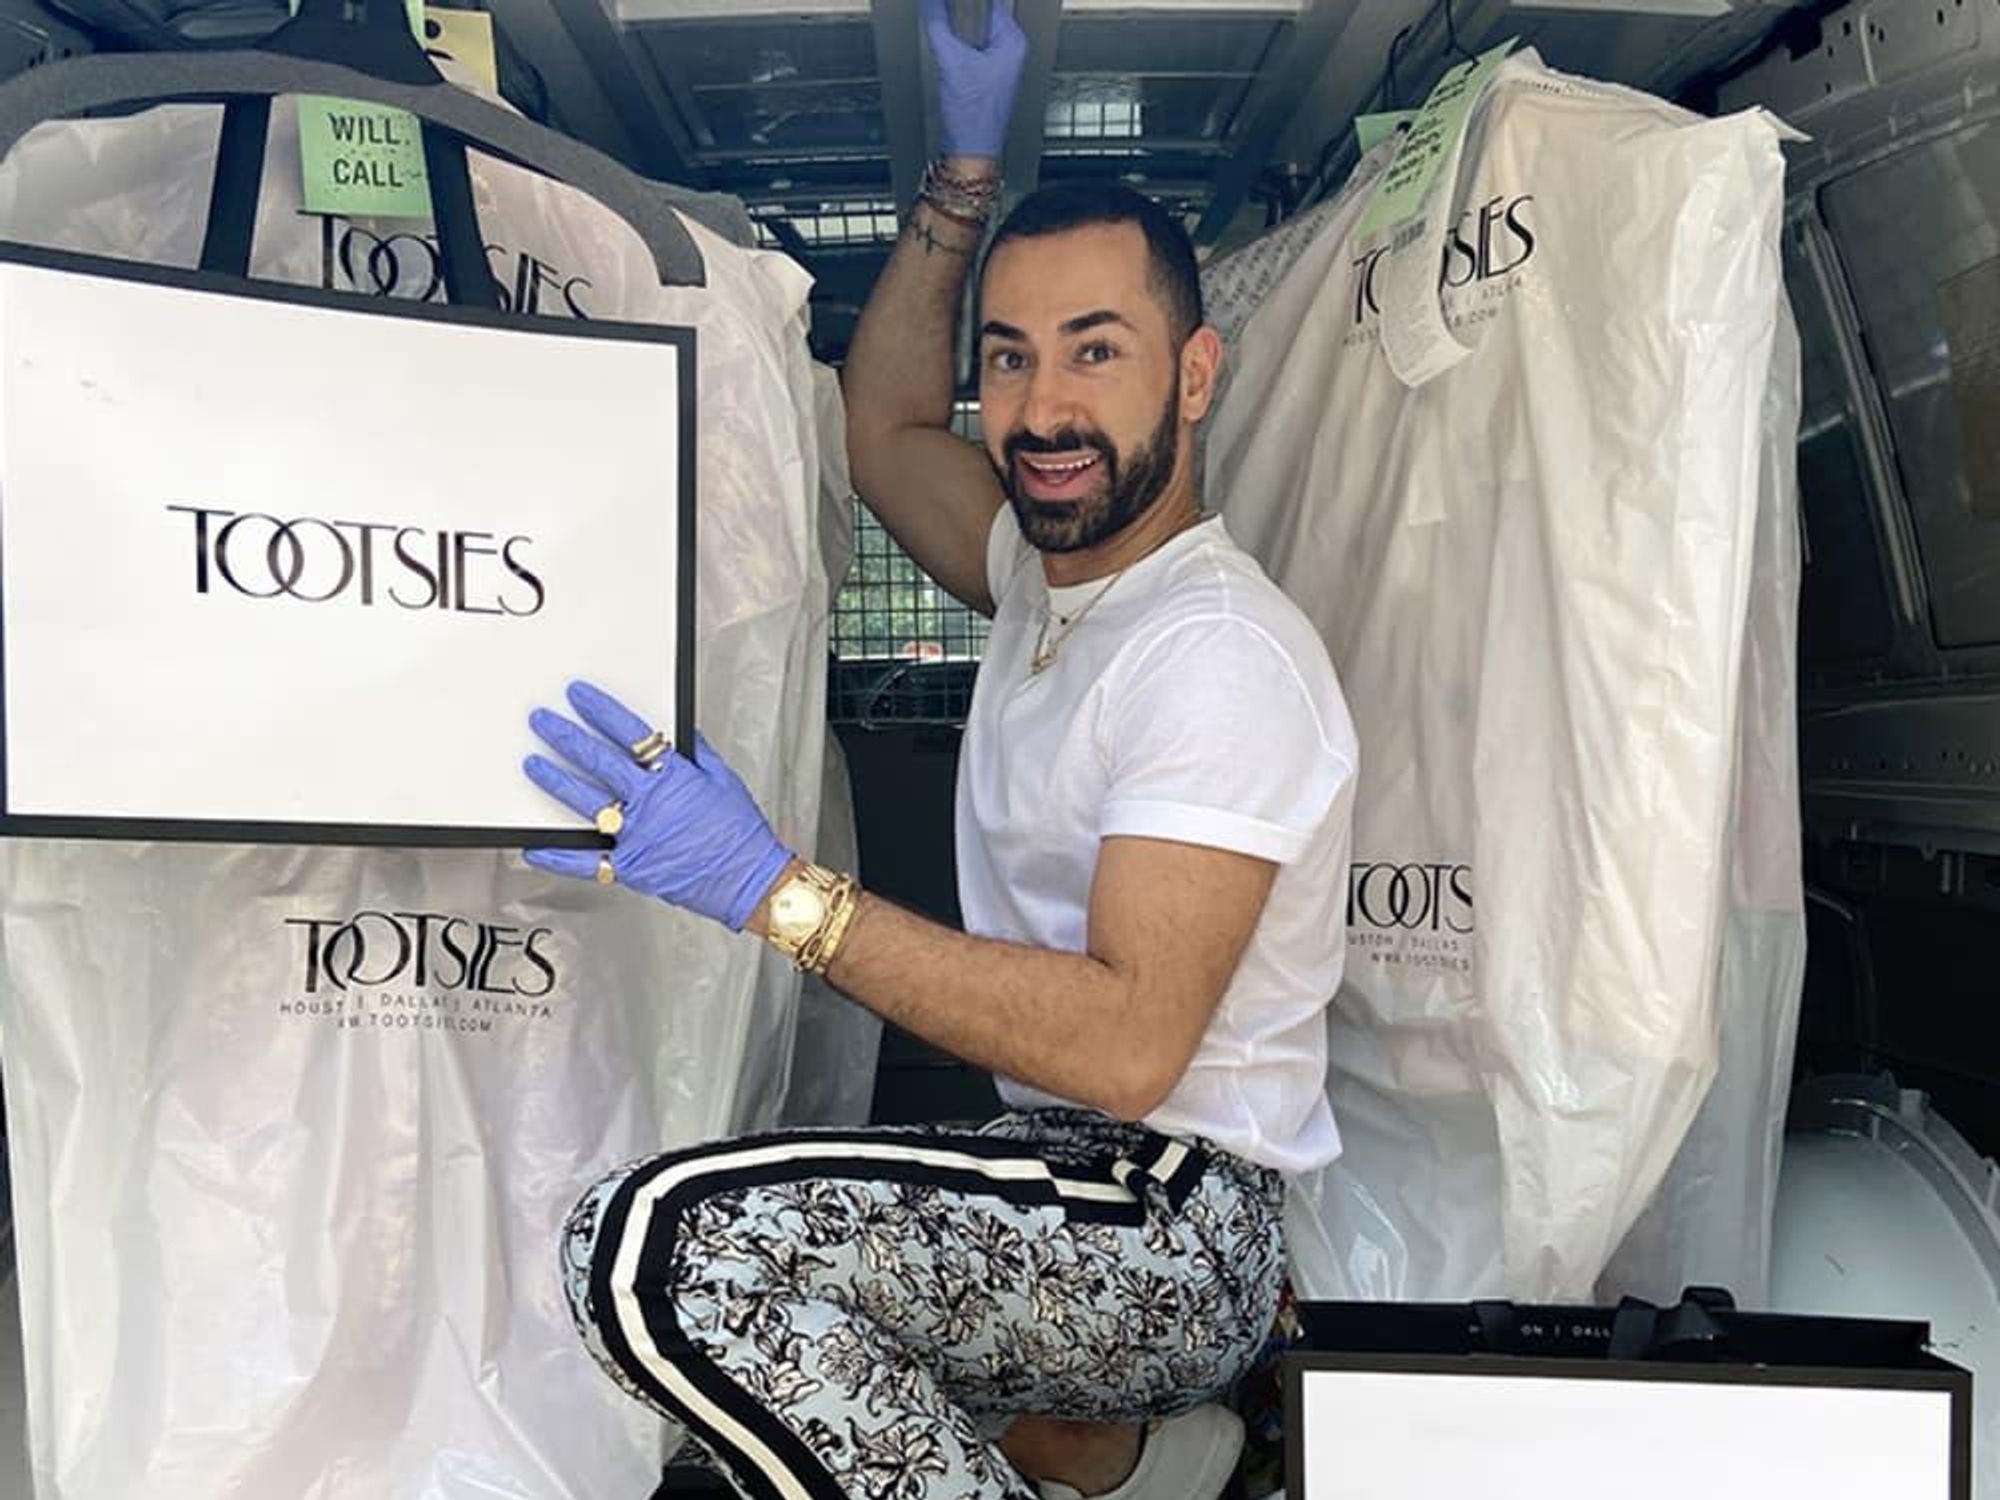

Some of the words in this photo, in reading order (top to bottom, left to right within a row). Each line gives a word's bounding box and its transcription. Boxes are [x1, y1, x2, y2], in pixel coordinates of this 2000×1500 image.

[328, 111, 400, 145] WILL
[333, 157, 403, 188] CALL
[296, 209, 592, 320] TOOSIES
[166, 504, 545, 617] TOOTSIES
